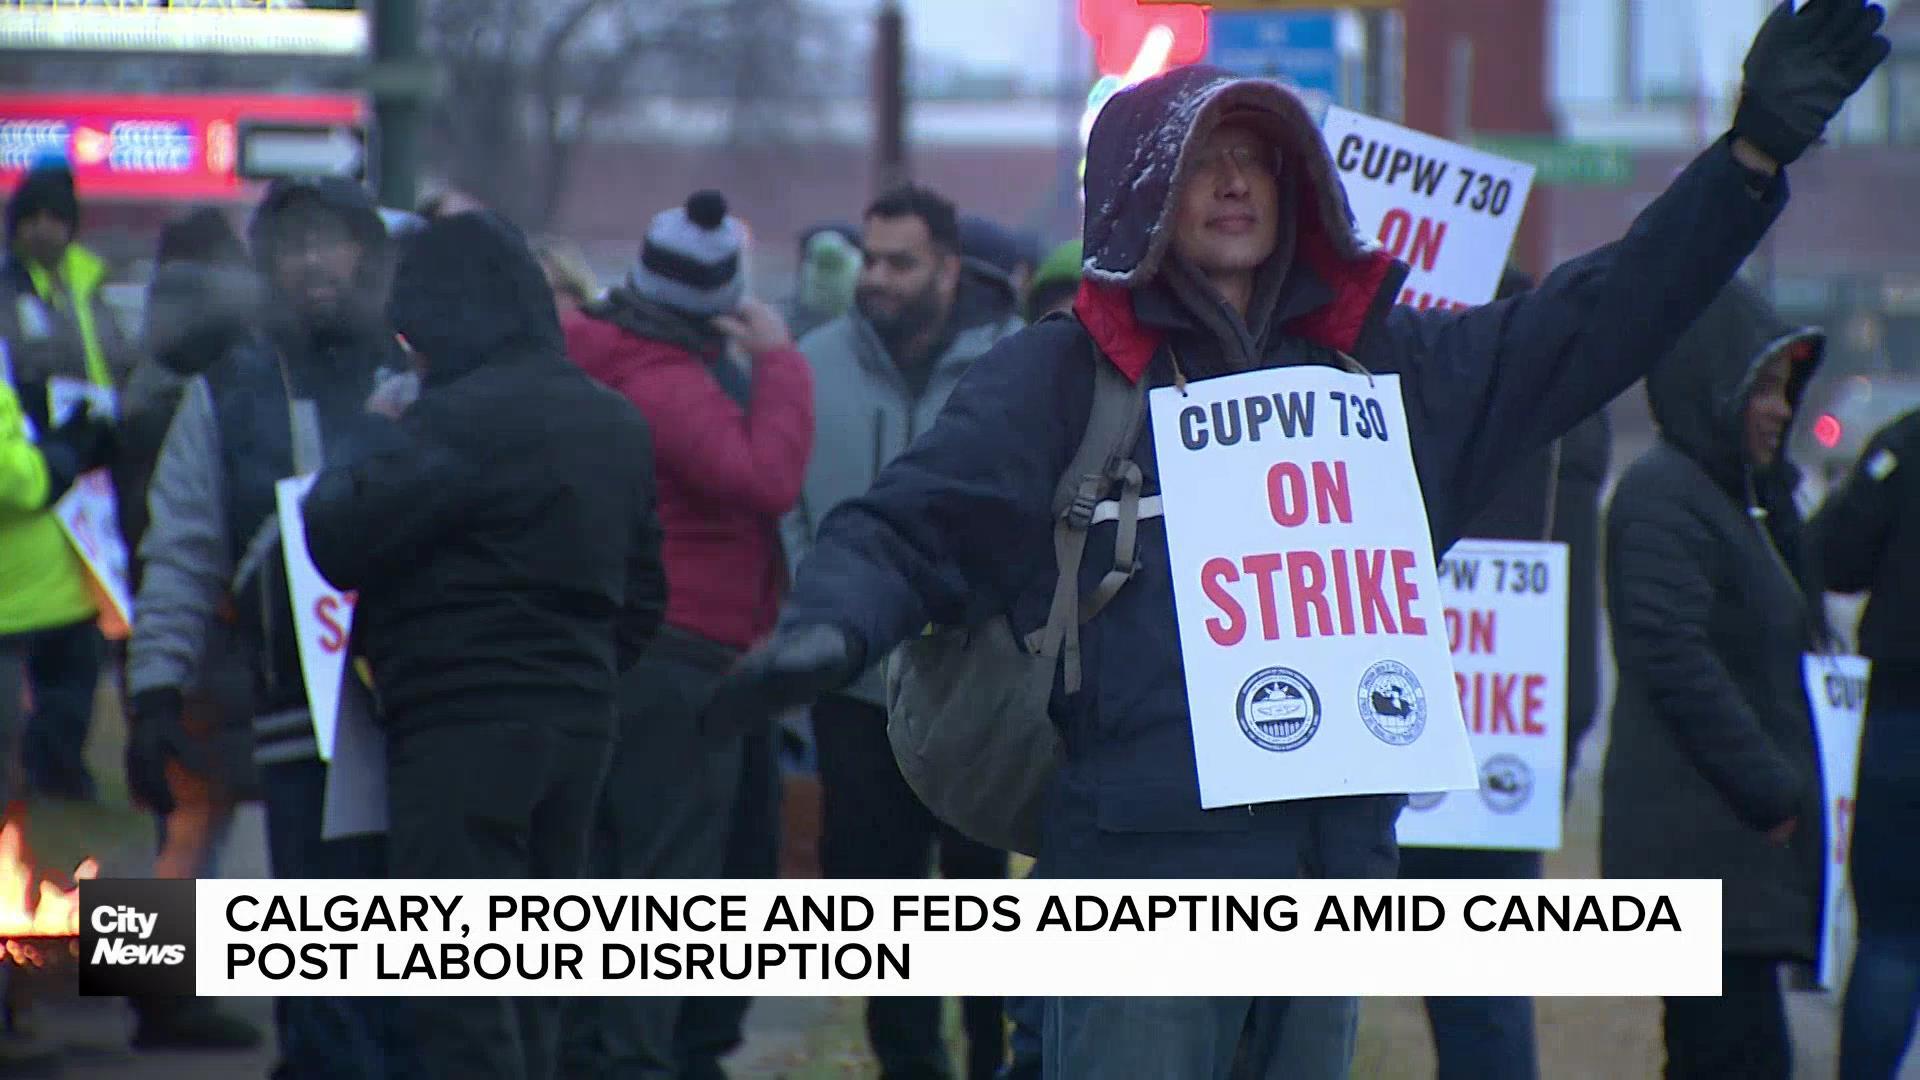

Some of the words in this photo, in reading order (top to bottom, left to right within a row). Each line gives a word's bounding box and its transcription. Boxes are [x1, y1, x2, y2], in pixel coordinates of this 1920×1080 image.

[1336, 133, 1448, 196] CUPW
[1454, 167, 1512, 216] 730
[1378, 207, 1447, 272] ON
[1179, 391, 1315, 451] CUPW
[1329, 391, 1388, 441] 730
[1266, 460, 1353, 528] ON
[1200, 549, 1428, 647] STRIKE
[1491, 559, 1549, 594] 730
[1443, 608, 1496, 655] ON
